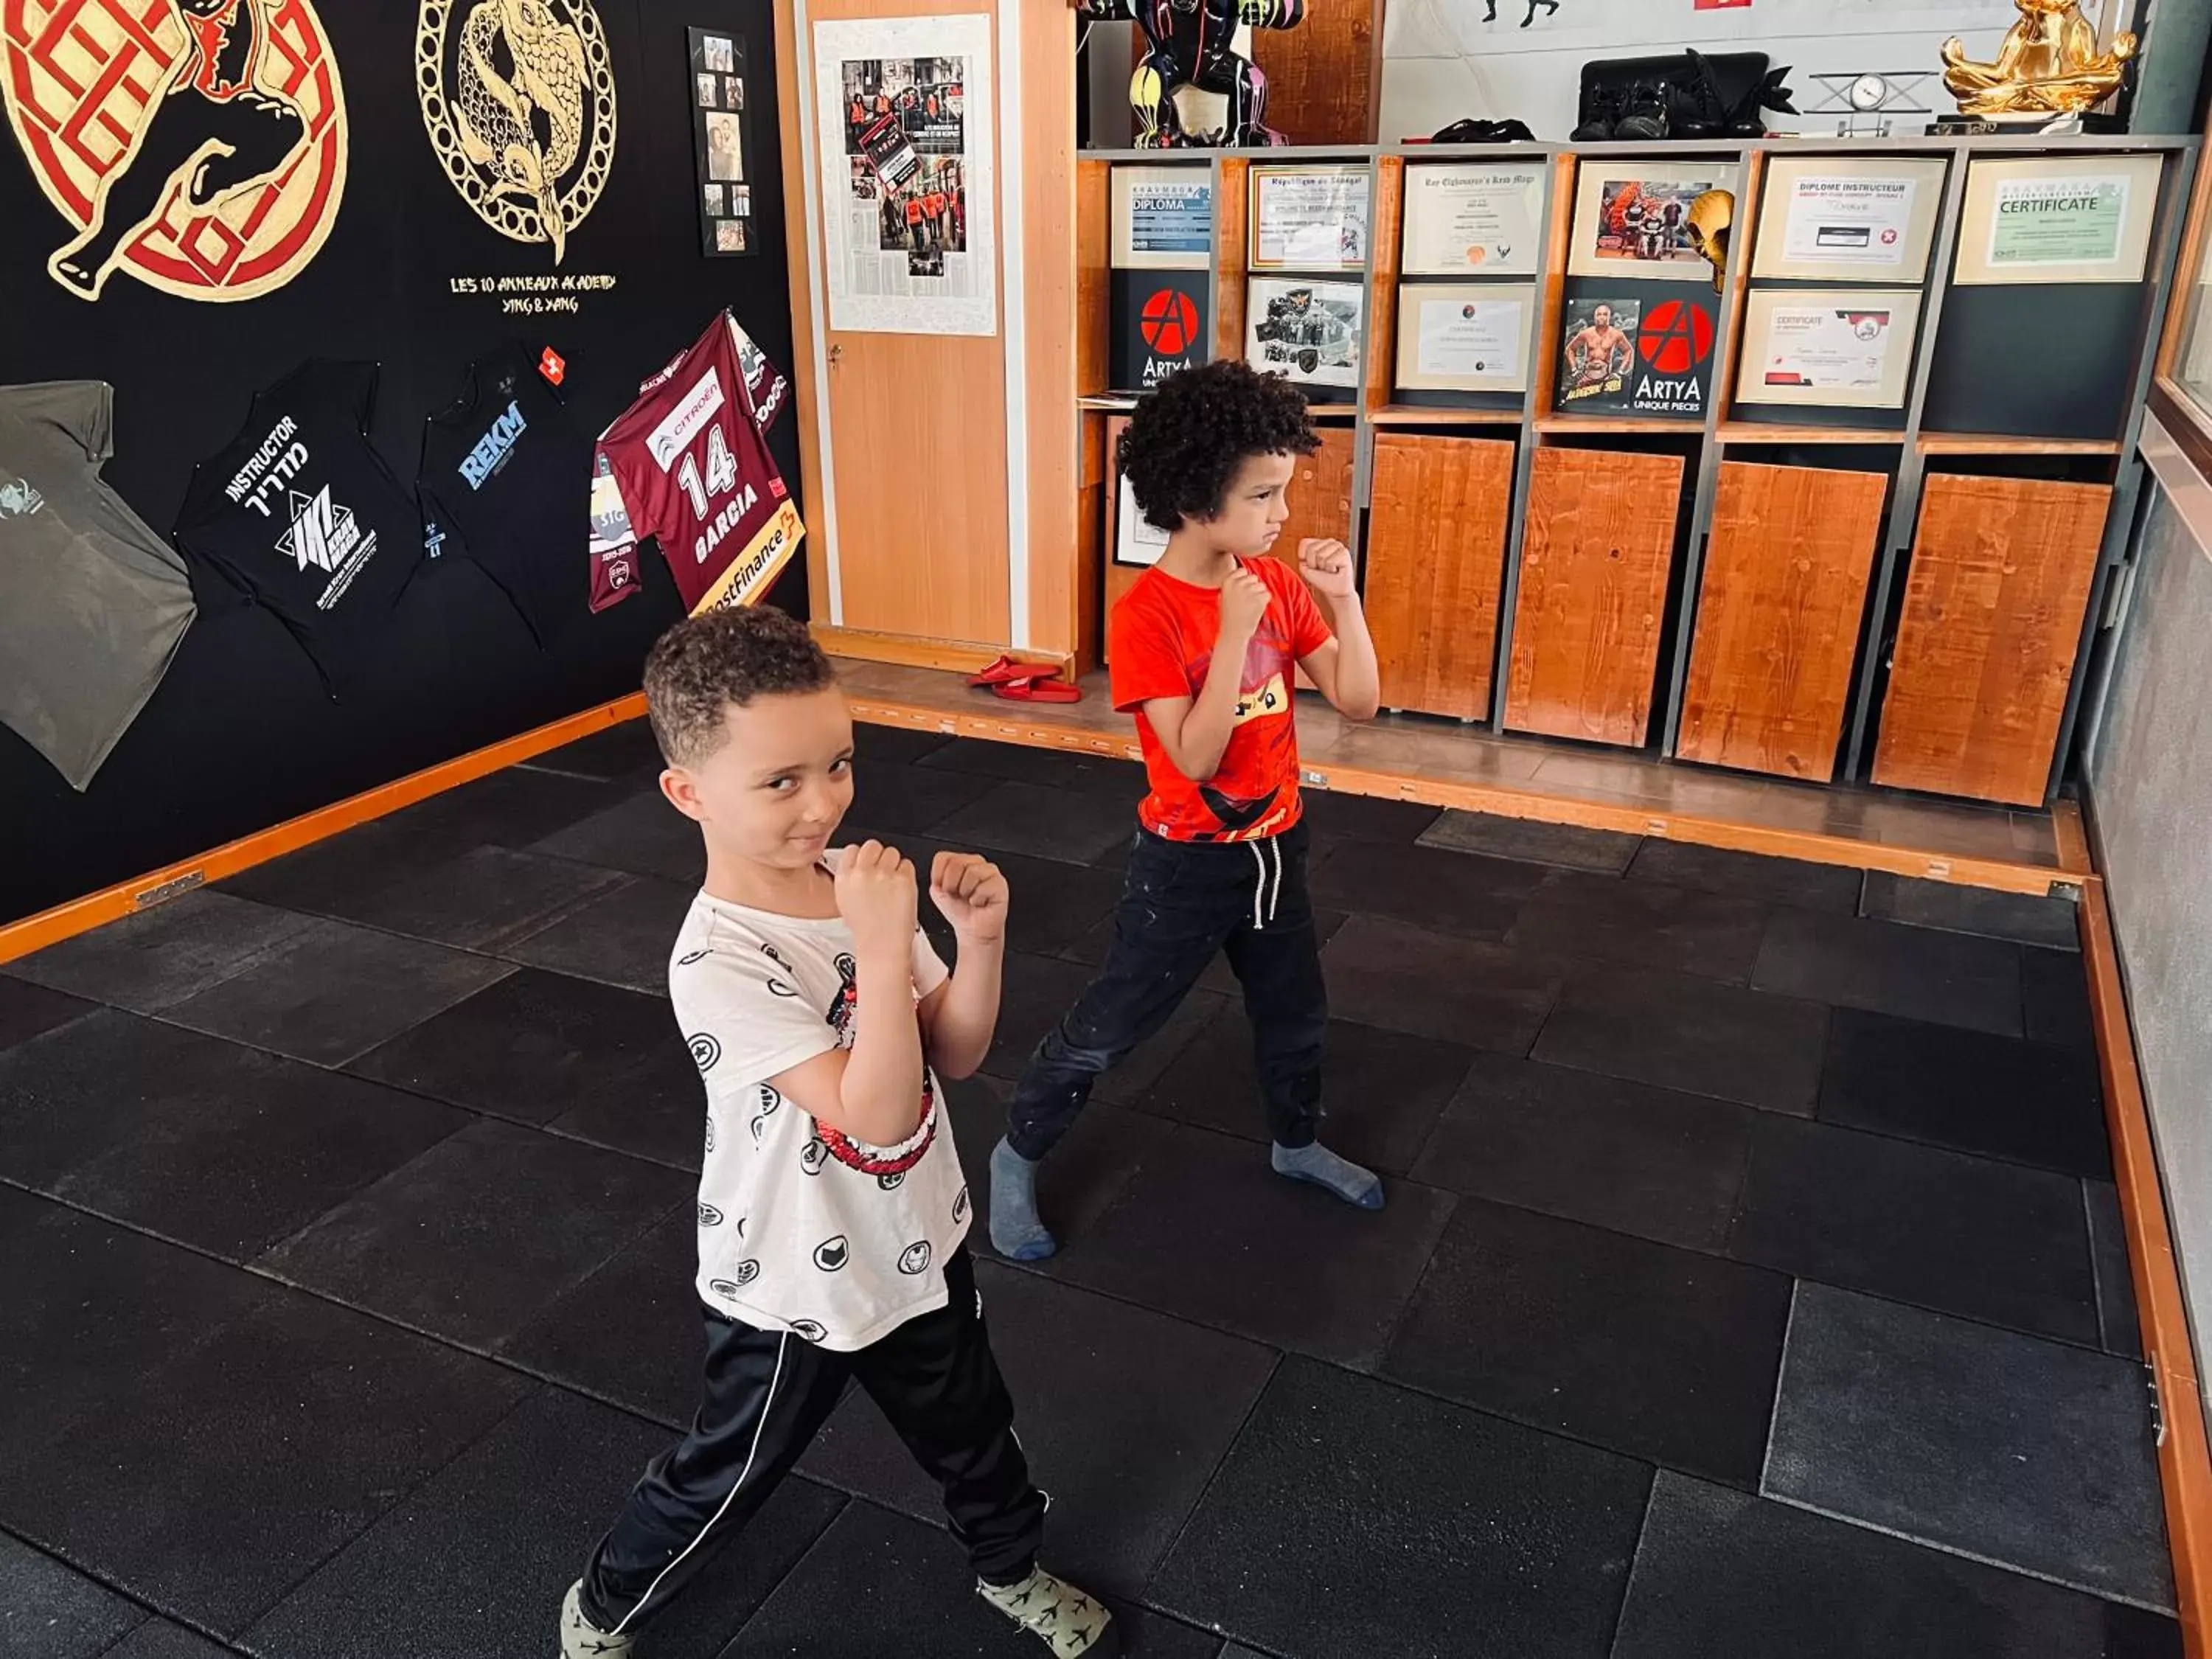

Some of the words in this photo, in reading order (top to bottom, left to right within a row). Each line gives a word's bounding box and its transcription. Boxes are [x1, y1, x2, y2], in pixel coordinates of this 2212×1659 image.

[1843, 184, 1905, 192] INSTRUCTEUR
[1133, 200, 1185, 210] DIPLOMA
[2000, 197, 2098, 213] CERTIFICATE
[451, 277, 478, 293] LES
[480, 276, 495, 293] 10
[497, 275, 560, 292] ANNEAUX
[502, 297, 532, 316] YING
[534, 297, 543, 312] &
[545, 296, 579, 315] YANG
[1634, 400, 1669, 411] UNIQUE
[1671, 401, 1700, 411] PIECES
[458, 400, 528, 490] REKM
[225, 415, 298, 503] INSTRUCTOR
[678, 423, 737, 521] 14
[601, 509, 625, 526] SIG
[695, 483, 759, 564] GARCIA
[704, 529, 782, 614] ostFinance
